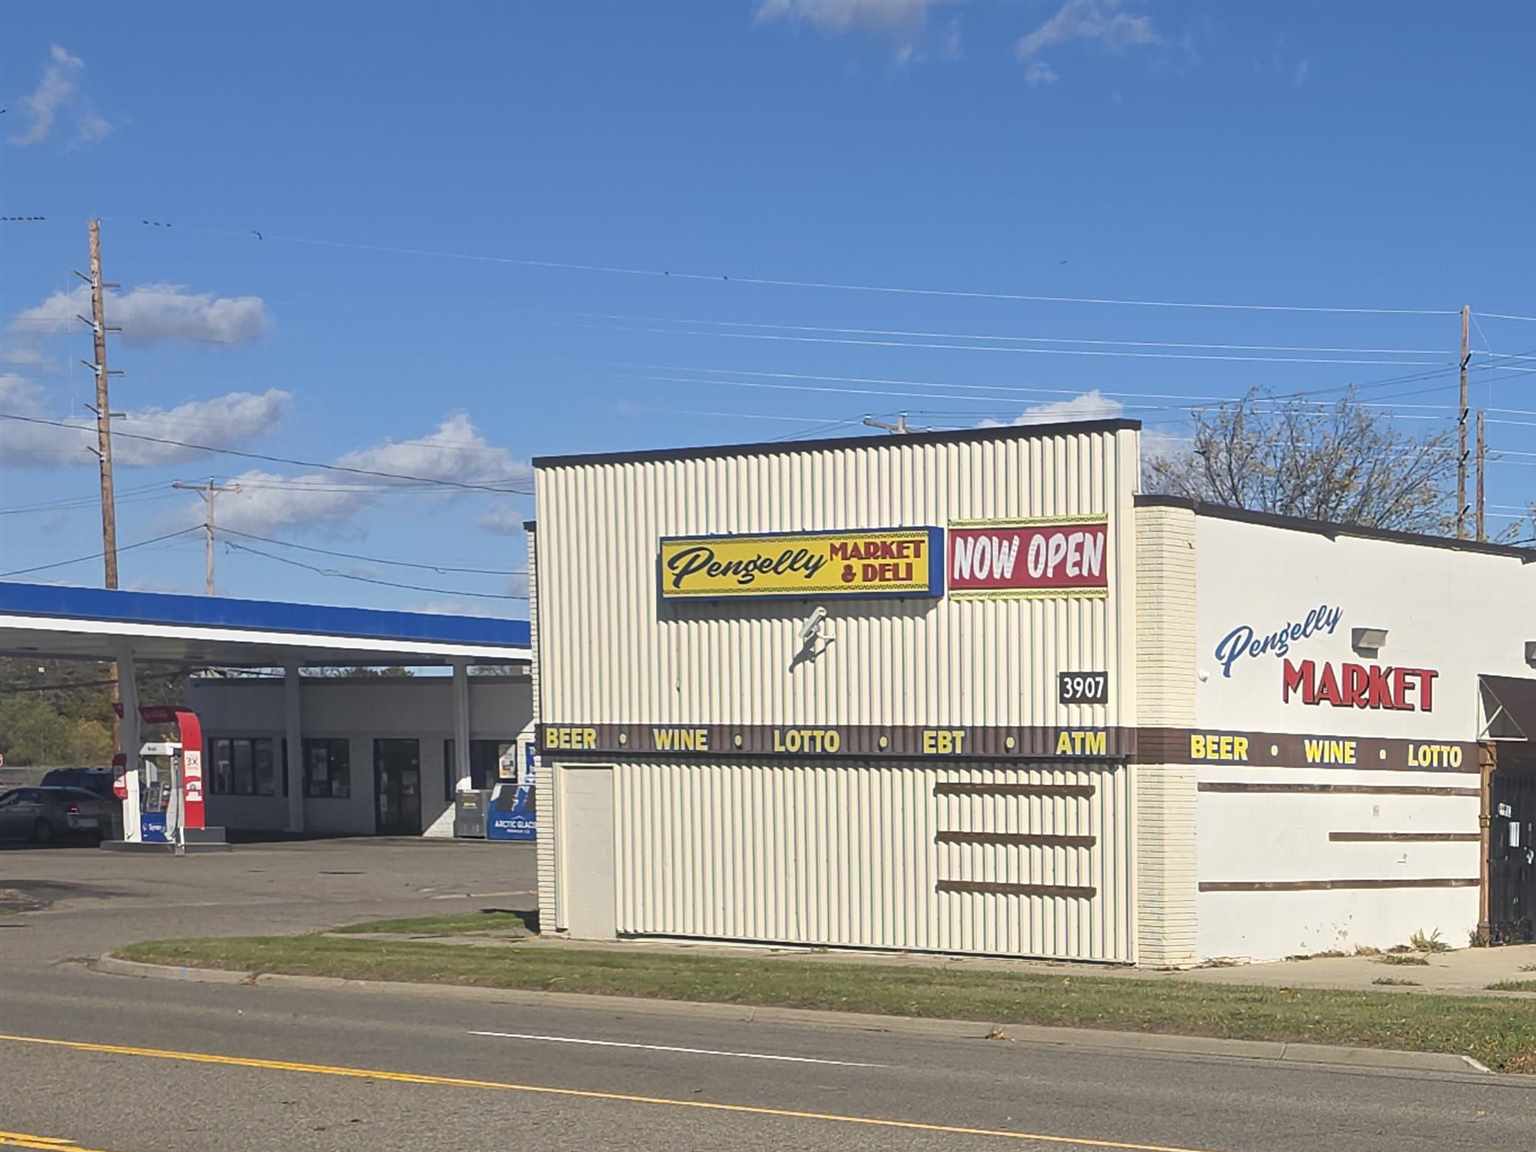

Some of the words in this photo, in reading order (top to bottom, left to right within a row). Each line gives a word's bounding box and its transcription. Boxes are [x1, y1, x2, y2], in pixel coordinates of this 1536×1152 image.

[667, 546, 828, 589] Pengelly
[829, 539, 926, 562] MARKET
[953, 535, 1020, 580] NOW
[1027, 532, 1105, 579] OPEN
[841, 564, 856, 583] &
[862, 562, 914, 582] DELI
[1214, 604, 1344, 678] Pengelly
[1063, 677, 1105, 698] 3907
[1282, 658, 1439, 712] MARKET
[546, 728, 597, 749] BEER
[653, 729, 709, 750] WINE
[774, 730, 840, 753] LOTTO
[923, 731, 965, 754] EBT
[1056, 731, 1106, 755] ATM
[1190, 734, 1249, 761] BEER
[1304, 739, 1357, 764] WINE
[1407, 743, 1463, 768] LOTTO
